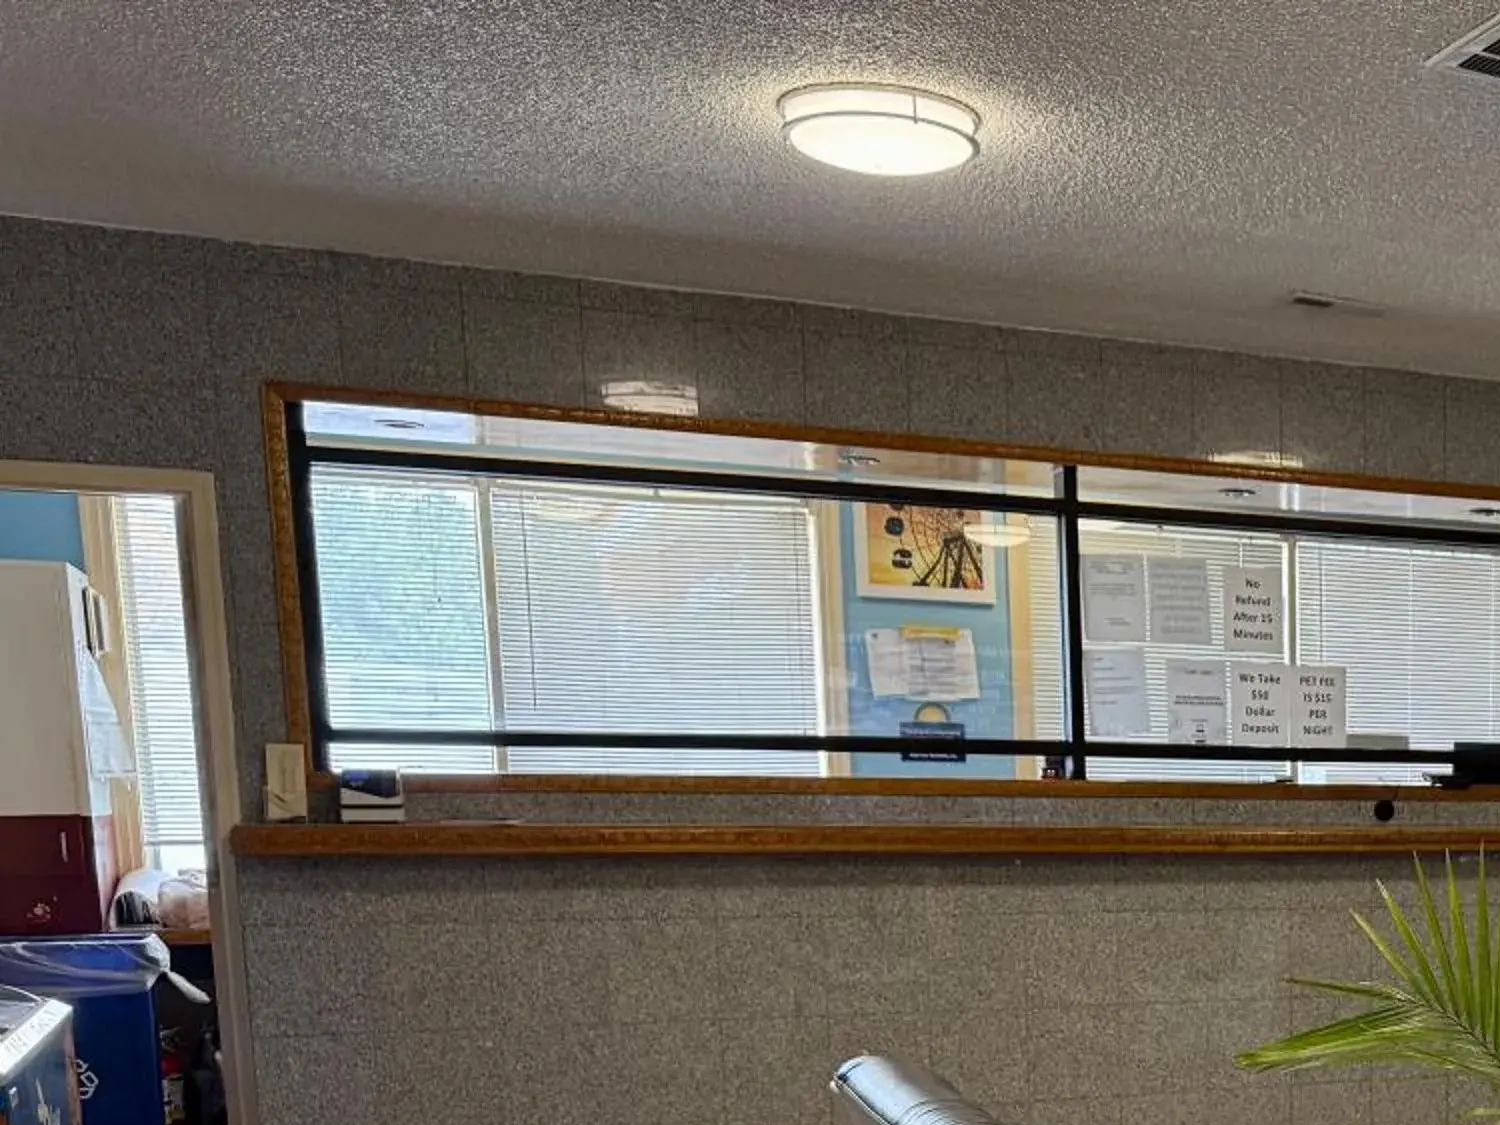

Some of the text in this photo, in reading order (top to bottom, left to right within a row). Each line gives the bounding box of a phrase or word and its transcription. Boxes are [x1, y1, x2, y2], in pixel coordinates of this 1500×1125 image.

[1245, 577, 1261, 589] No
[1235, 594, 1272, 607] Refund
[1233, 611, 1258, 623] After
[1233, 627, 1274, 641] Minutes
[1239, 673, 1281, 685] We Take
[1299, 675, 1335, 688] PET FEE
[1303, 692, 1312, 703] IS
[1245, 705, 1276, 717] Dollar
[1308, 708, 1327, 719] PER
[1241, 723, 1280, 736] Deposit
[1303, 724, 1334, 736] NIGHT
